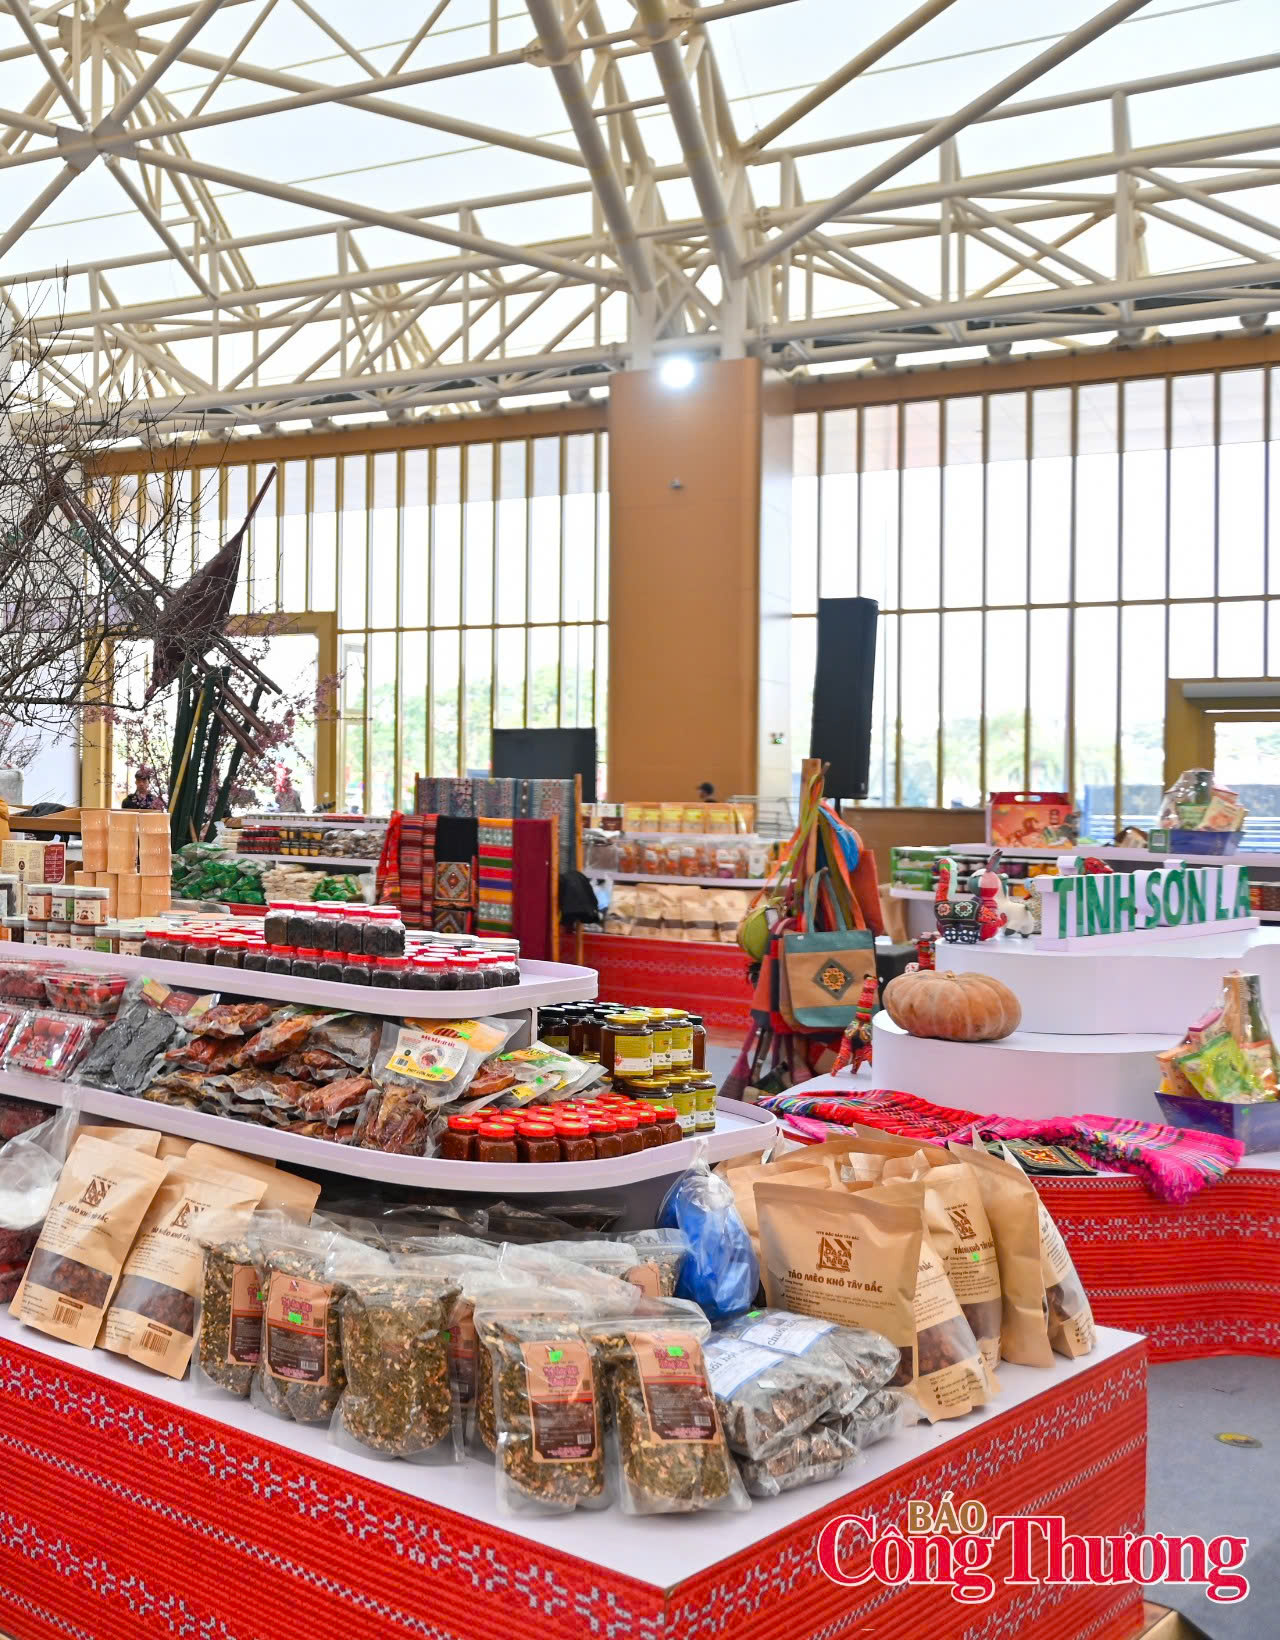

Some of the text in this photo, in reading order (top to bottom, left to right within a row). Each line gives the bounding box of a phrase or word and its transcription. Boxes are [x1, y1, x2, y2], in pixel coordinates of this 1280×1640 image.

[1145, 860, 1207, 931] SƠN
[1215, 865, 1252, 922] LA
[804, 1272, 824, 1283] MÈO
[826, 1277, 845, 1287] KHÔ
[847, 1279, 862, 1290] TÂY
[864, 1281, 883, 1293] BẮC
